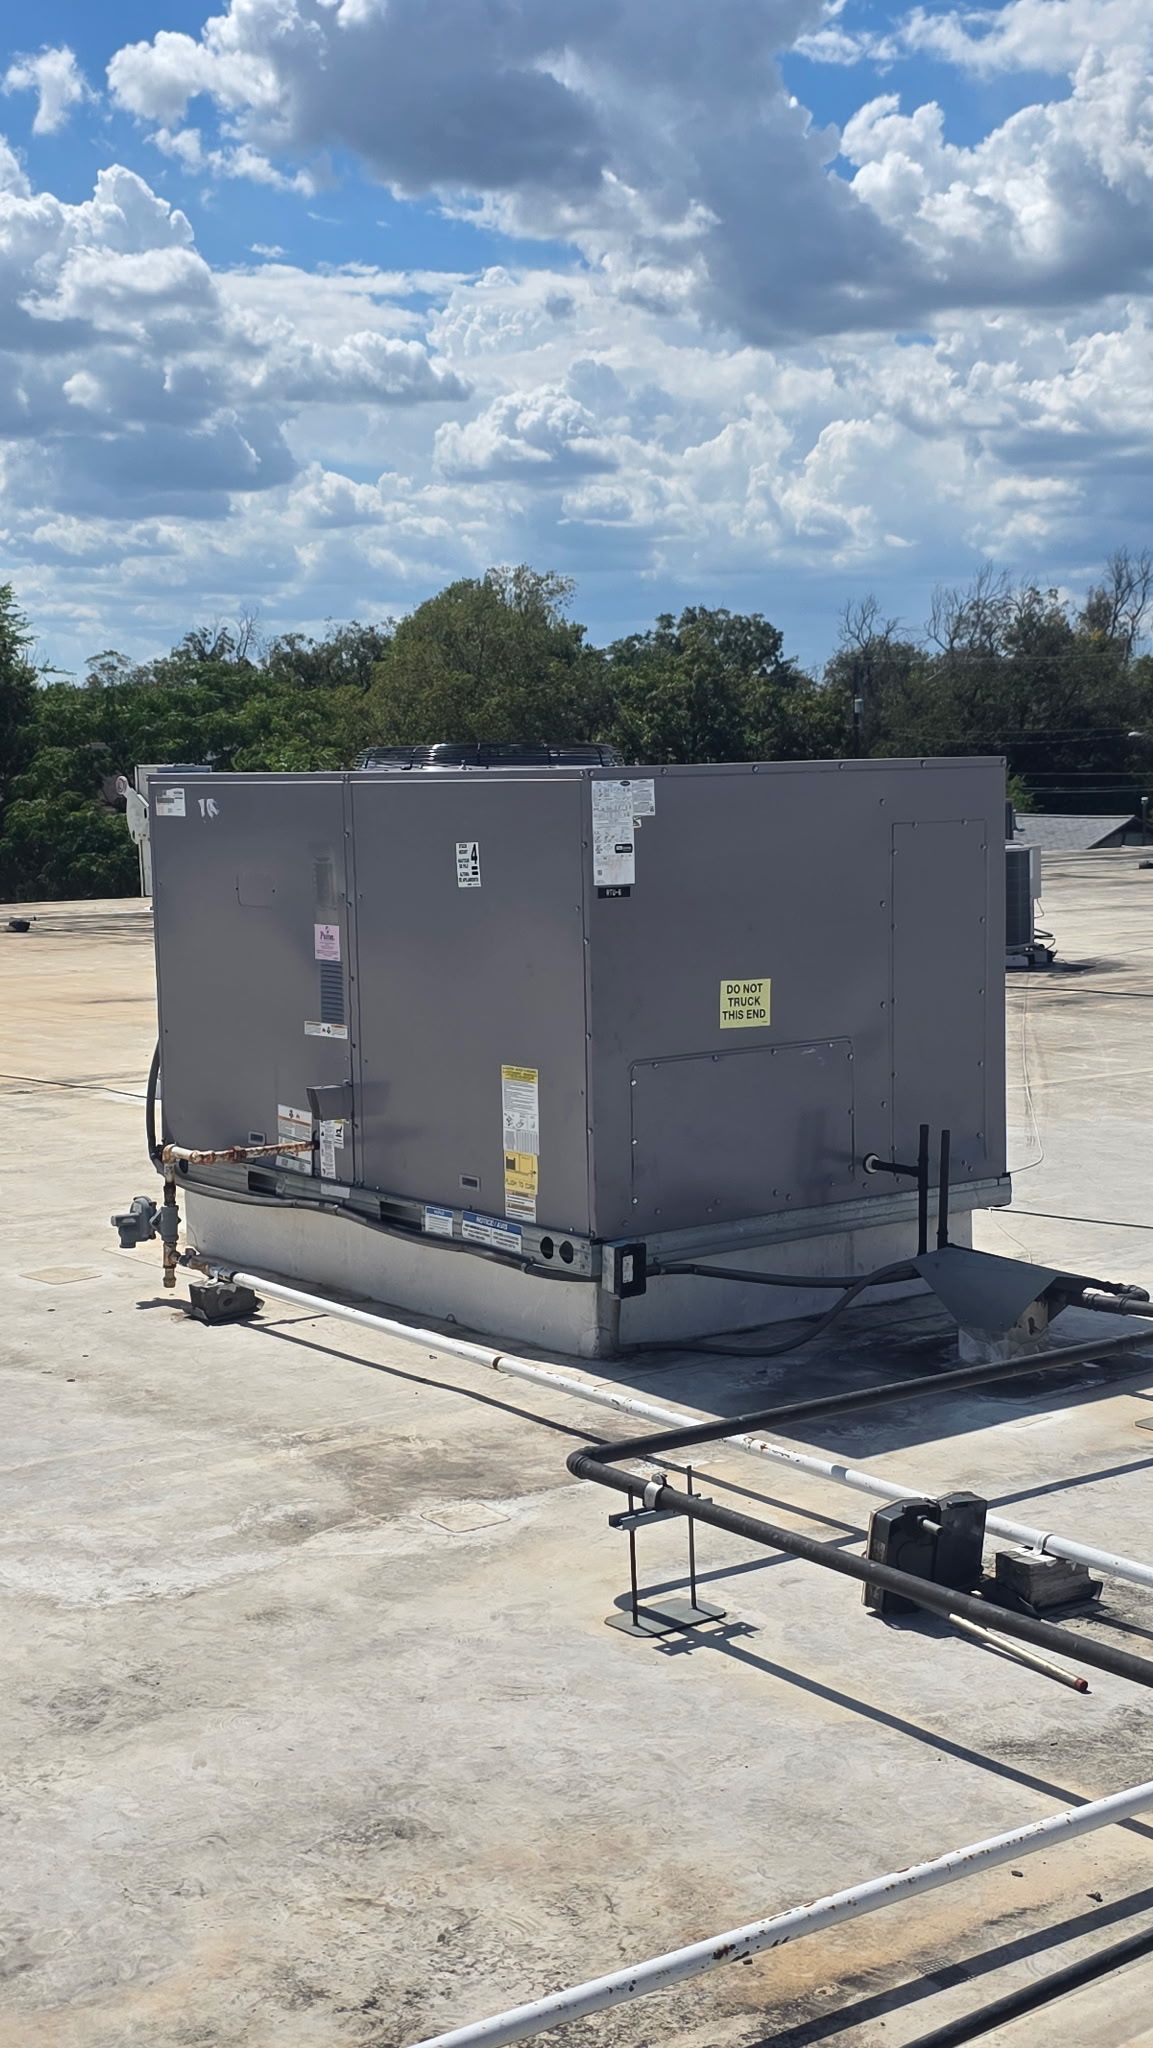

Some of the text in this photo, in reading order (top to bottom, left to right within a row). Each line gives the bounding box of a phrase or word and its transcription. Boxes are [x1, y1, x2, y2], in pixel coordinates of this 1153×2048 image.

[471, 843, 478, 864] 4
[727, 983, 763, 994] DO NOT
[728, 996, 761, 1007] TRUCK
[722, 1009, 766, 1020] THIS END
[476, 1216, 494, 1226] NOTICE
